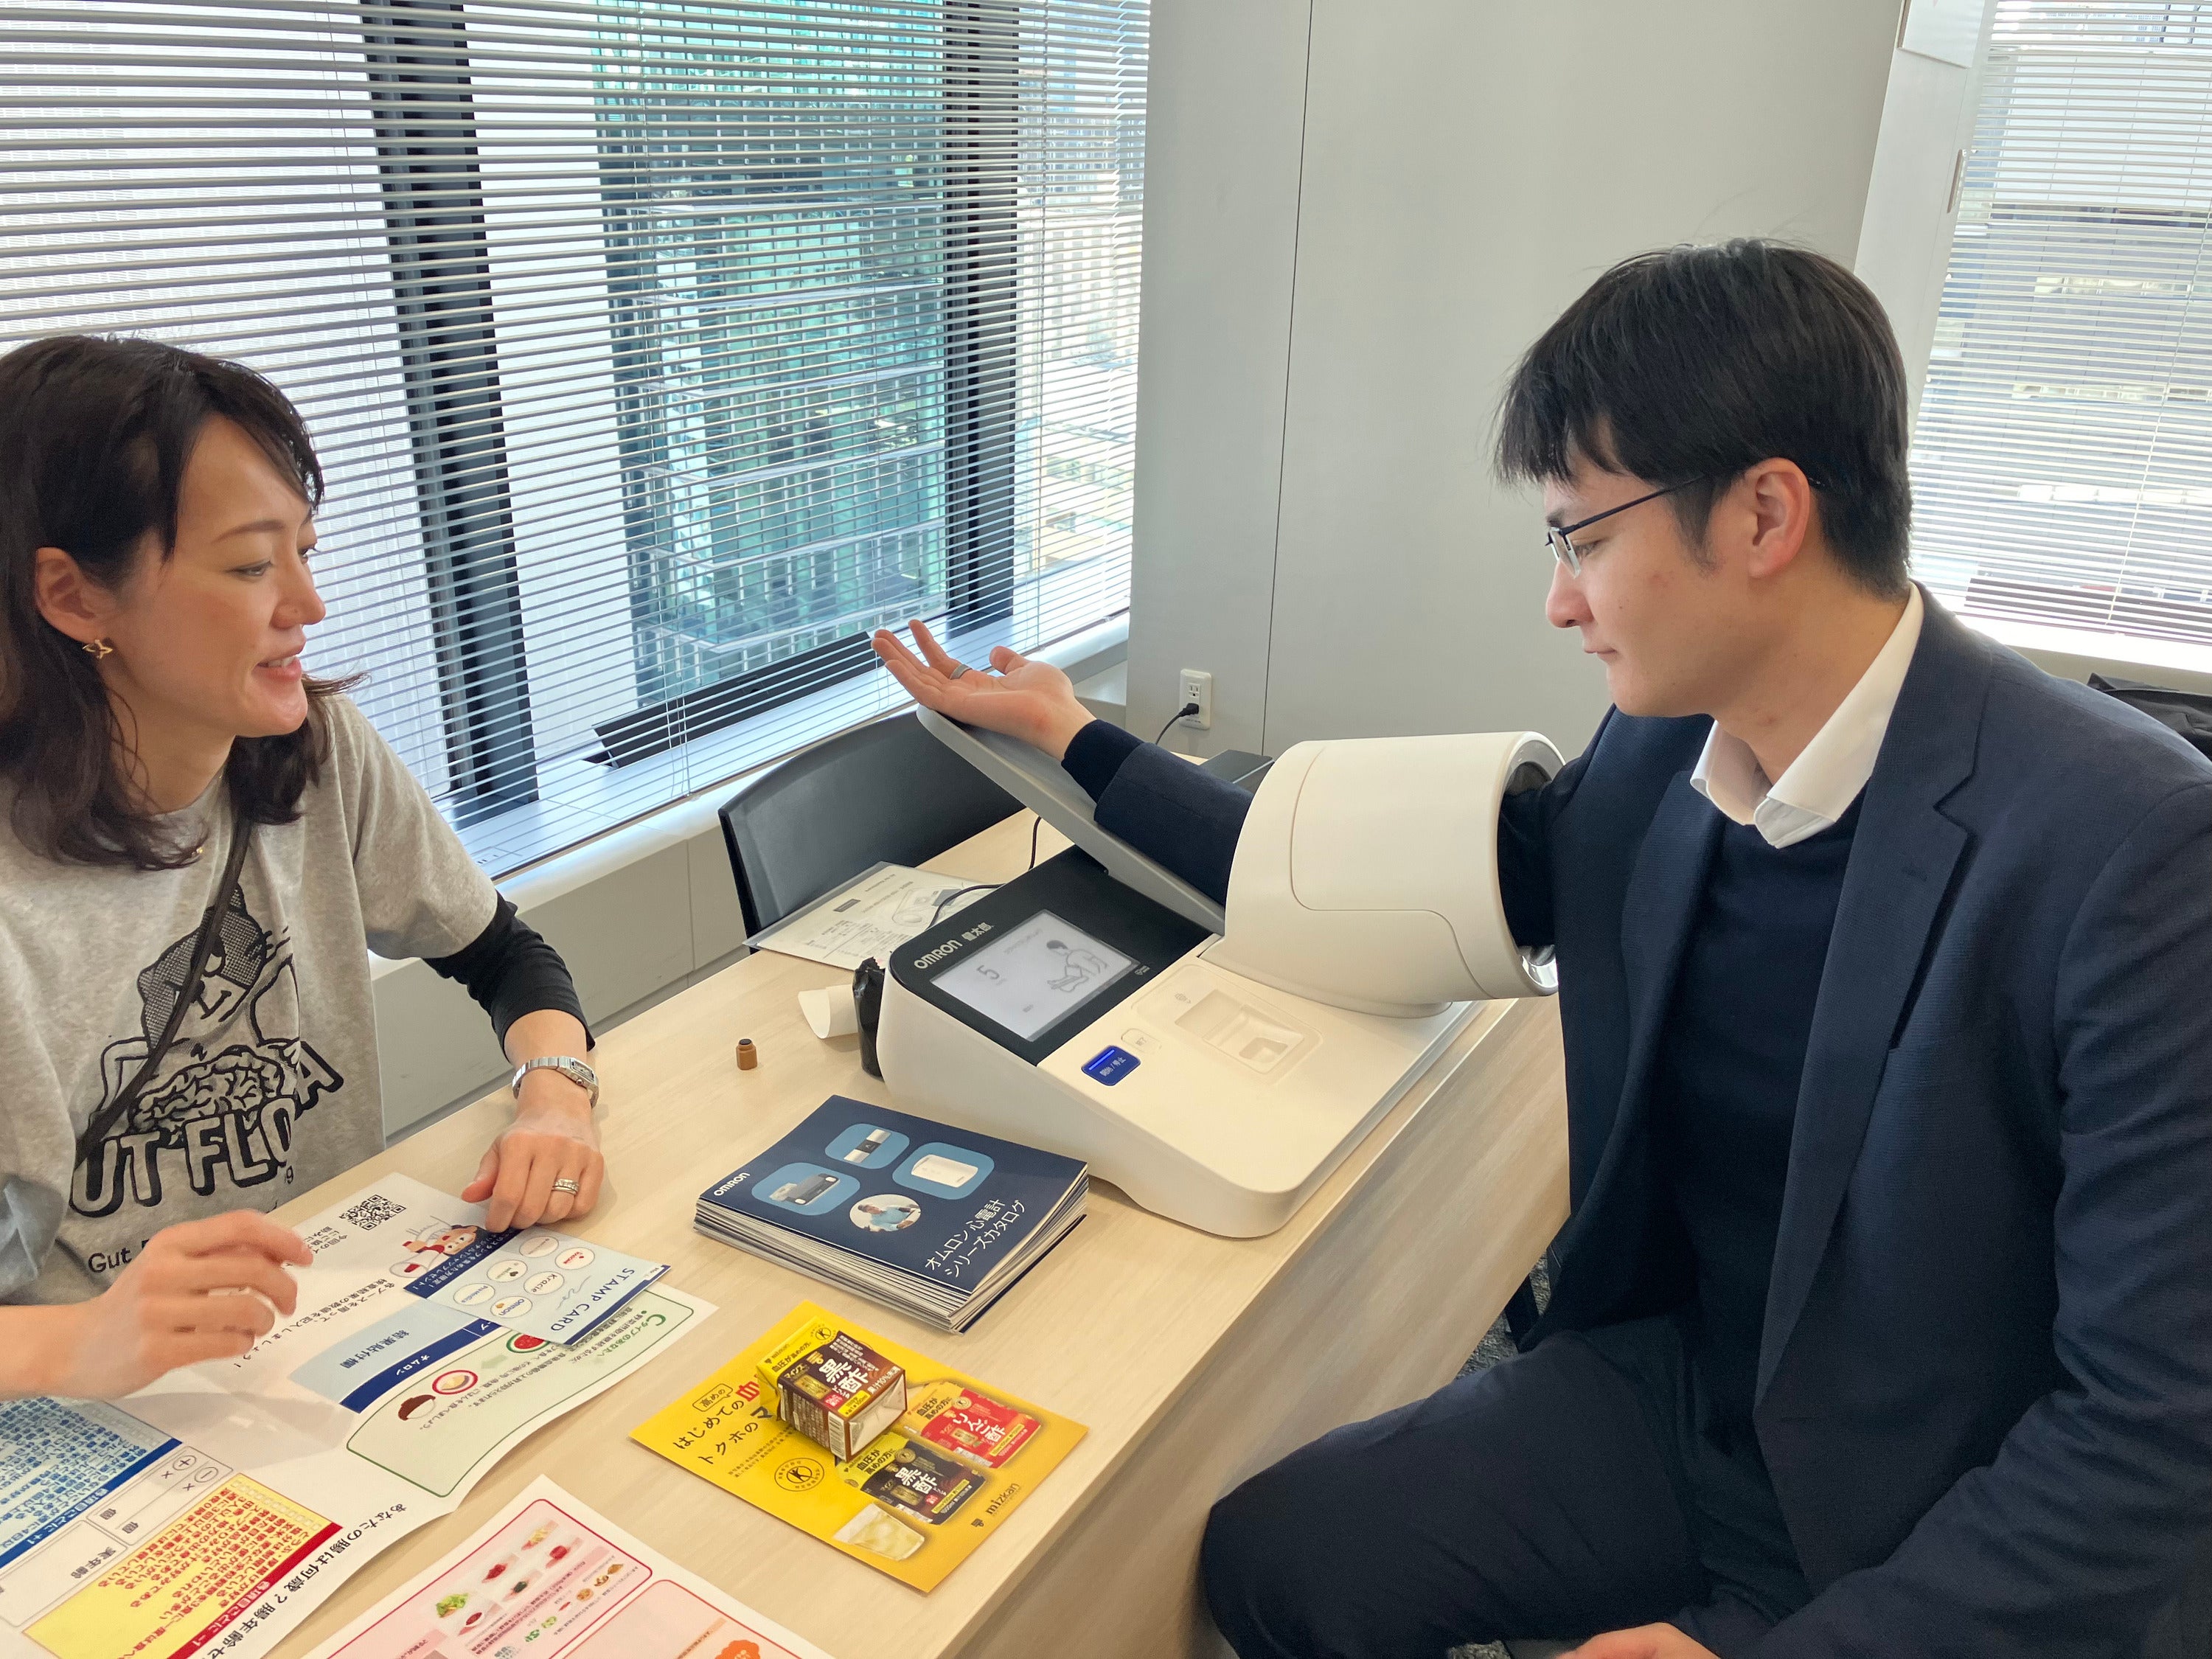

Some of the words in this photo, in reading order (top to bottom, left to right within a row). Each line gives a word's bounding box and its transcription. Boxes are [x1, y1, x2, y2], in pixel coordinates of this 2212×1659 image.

[961, 922, 992, 941] 健太郎
[914, 940, 963, 970] OMRON
[976, 965, 1000, 980] 5
[713, 1172, 751, 1196] OMRON
[922, 1228, 973, 1273] オムロン
[963, 1197, 1008, 1232] 心電計
[942, 1198, 1029, 1279] シリーズカタログ
[88, 1247, 132, 1273] Gut
[528, 1273, 559, 1293] Kracie
[586, 1267, 637, 1301] STAMP
[546, 1302, 593, 1332] CARD
[340, 1329, 410, 1369] 結果貼付欄
[396, 1354, 430, 1376] オムロン
[819, 1359, 869, 1393] 黒酢
[700, 1388, 726, 1407] 高めの
[917, 1398, 938, 1416] 血圧が
[698, 1406, 773, 1464] トクホのマ
[953, 1413, 1006, 1442] りんご酢
[857, 1450, 880, 1470] 血圧が
[895, 1467, 938, 1494] 黒酢
[986, 1484, 1020, 1514] mizkan
[97, 1507, 119, 1520] 個
[119, 1520, 141, 1534] 個
[69, 1546, 117, 1579] 実年齢
